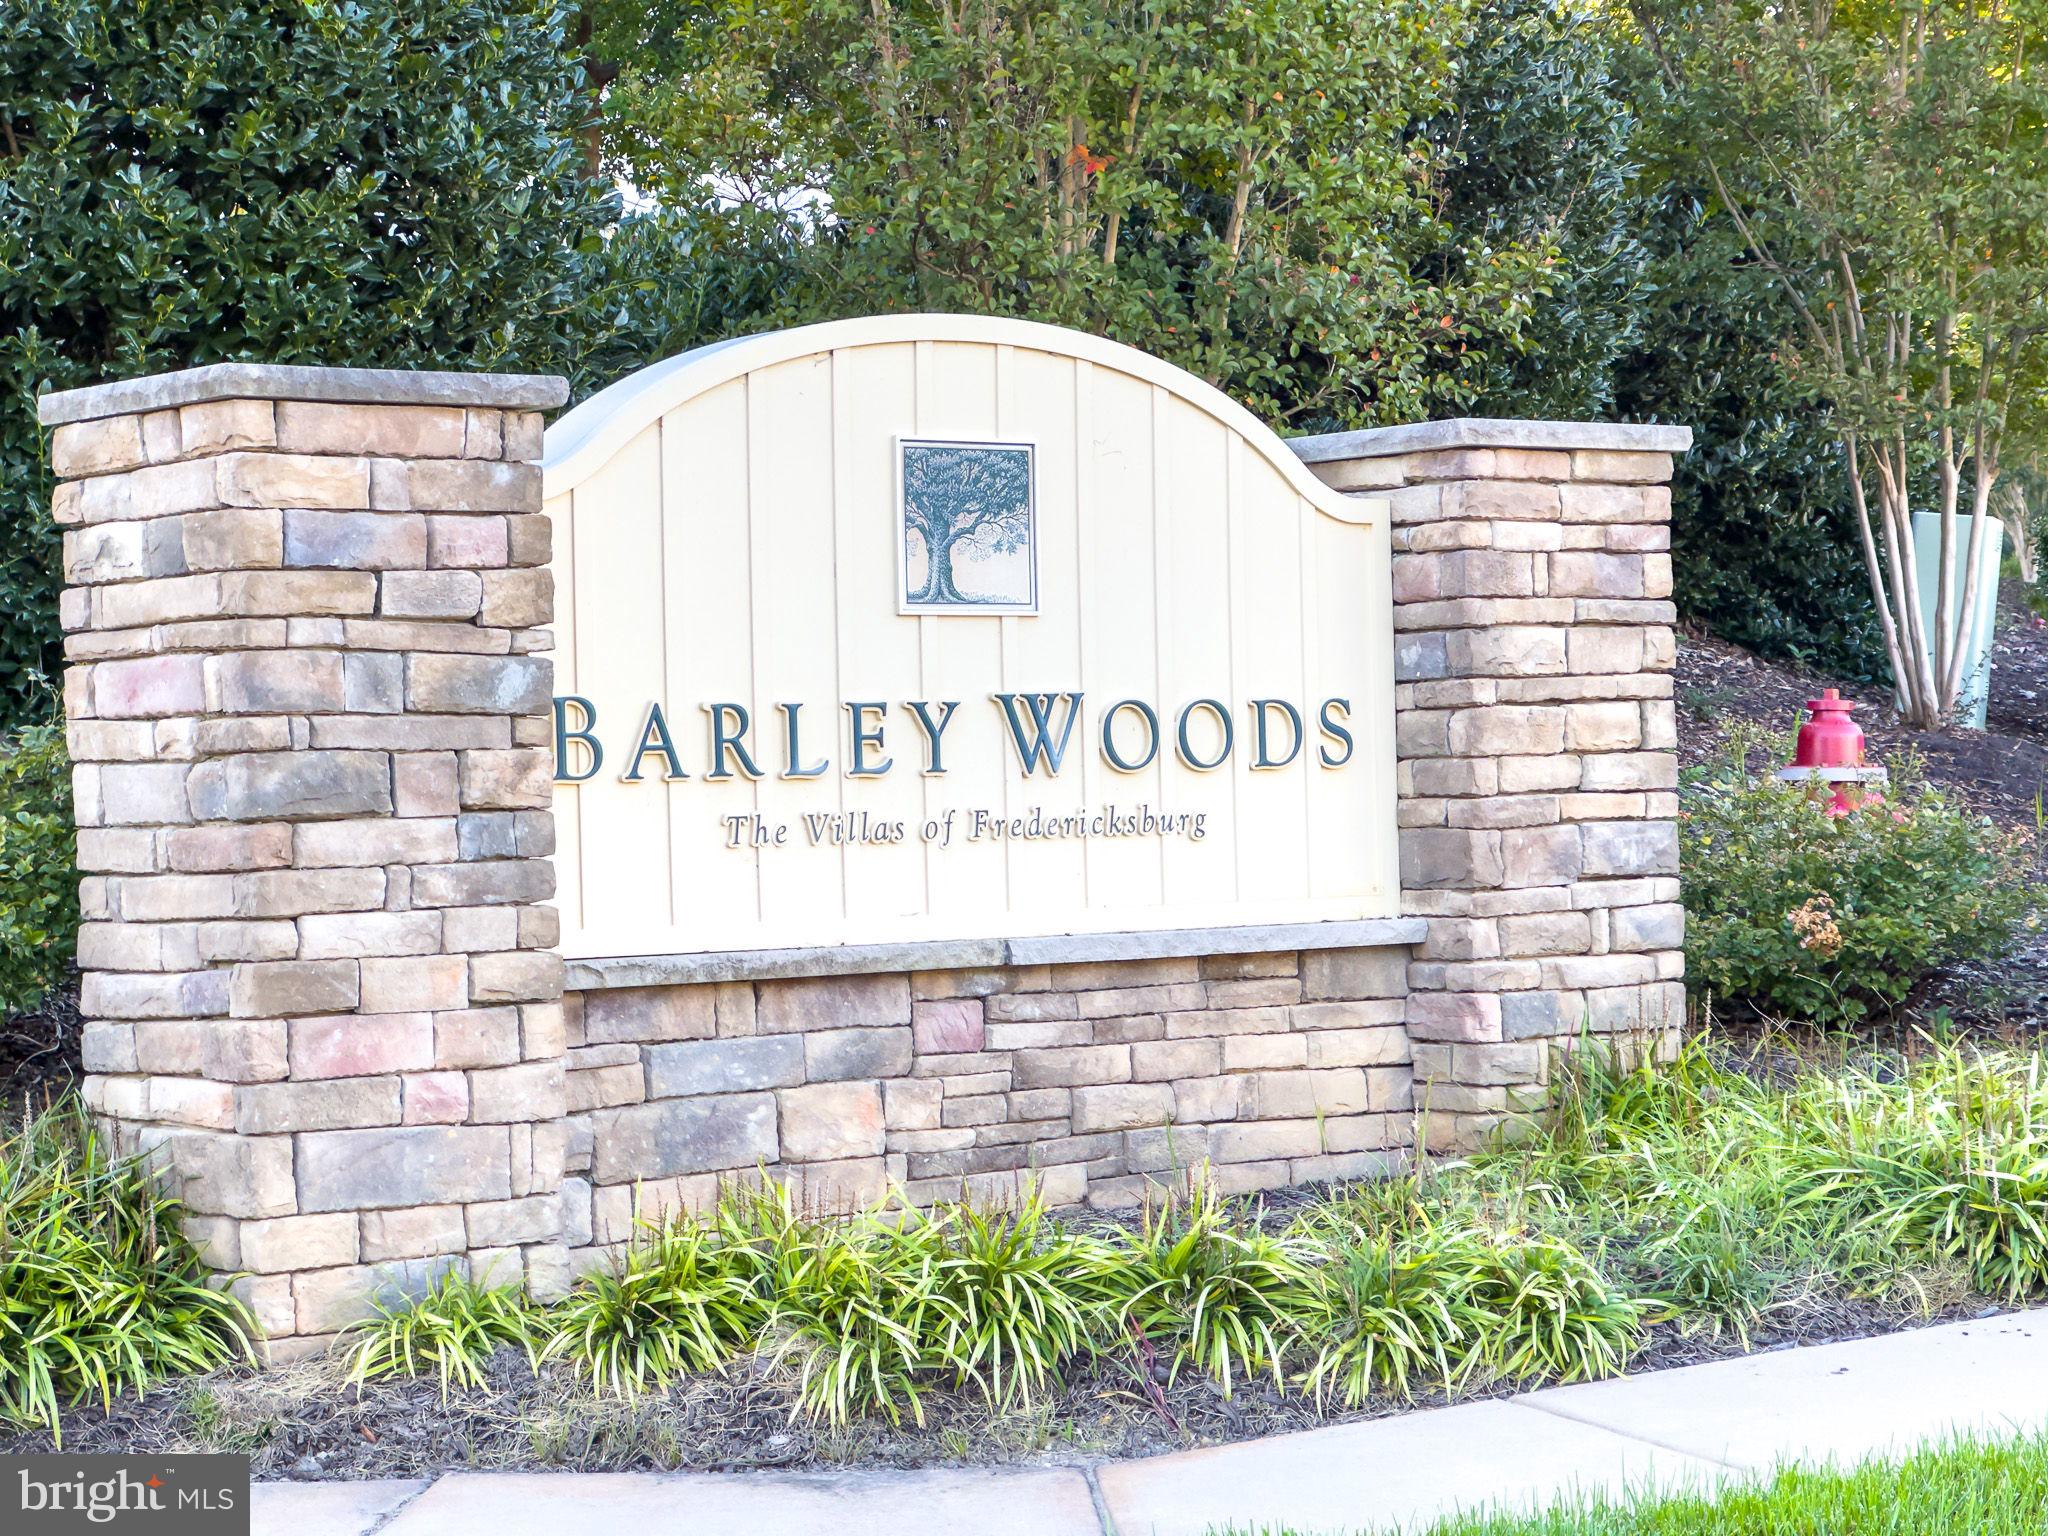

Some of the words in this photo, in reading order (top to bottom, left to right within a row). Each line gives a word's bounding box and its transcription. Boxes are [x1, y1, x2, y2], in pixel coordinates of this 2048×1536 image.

[553, 695, 961, 781] BARLEY
[992, 692, 1354, 776] WOODS
[725, 815, 787, 846] The
[805, 811, 905, 844] Villas
[924, 810, 957, 847] of
[971, 805, 1207, 840] Fredericksburg
